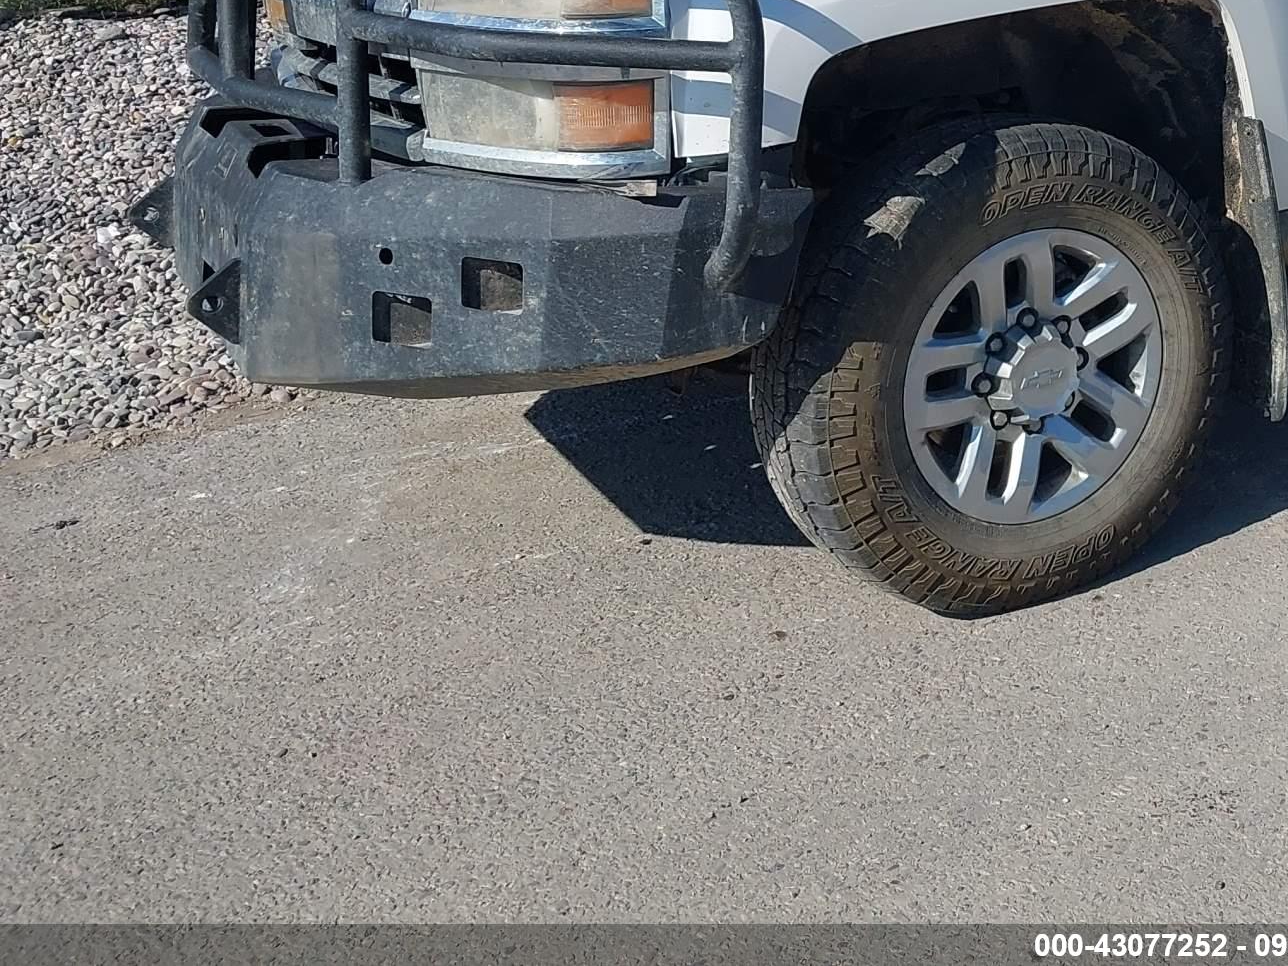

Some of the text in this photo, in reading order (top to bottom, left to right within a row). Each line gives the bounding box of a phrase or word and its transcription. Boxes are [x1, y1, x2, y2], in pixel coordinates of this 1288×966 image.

[980, 181, 1074, 227] OPEN
[1072, 182, 1178, 245] RANGE
[904, 525, 1024, 582] RANGE
[1022, 523, 1117, 580] OPEN
